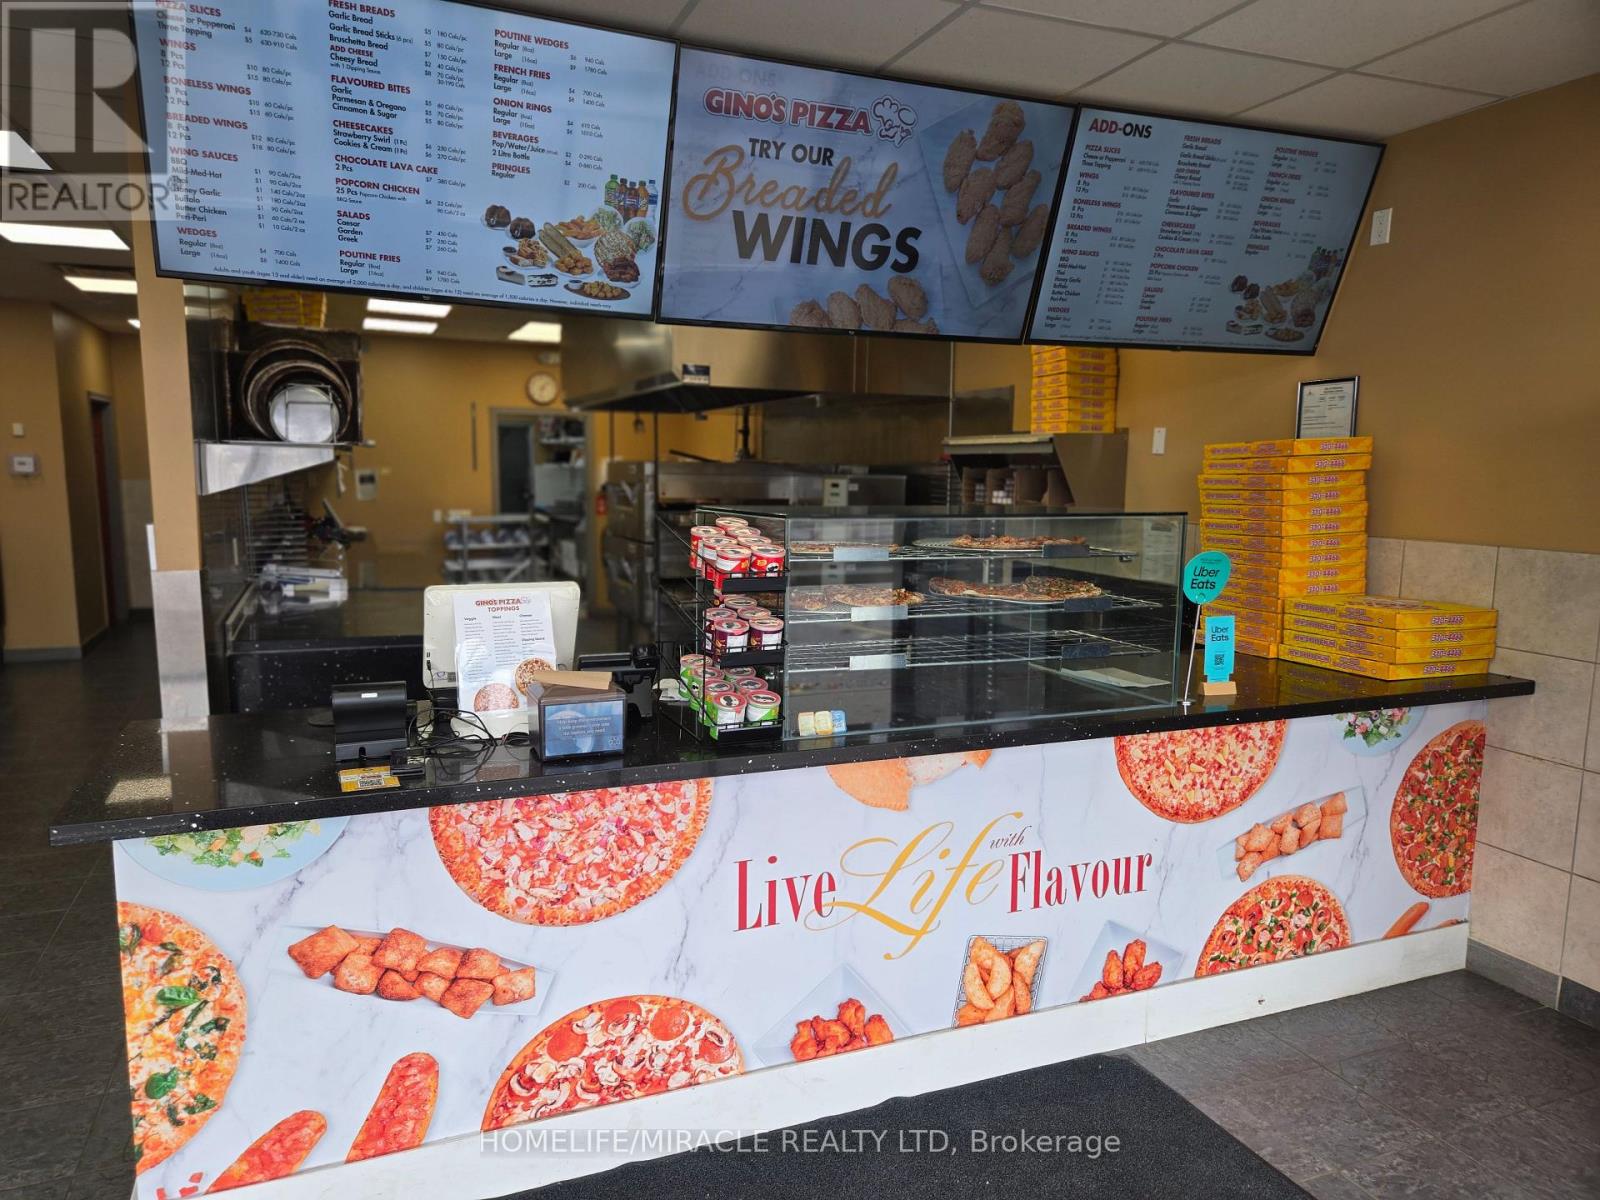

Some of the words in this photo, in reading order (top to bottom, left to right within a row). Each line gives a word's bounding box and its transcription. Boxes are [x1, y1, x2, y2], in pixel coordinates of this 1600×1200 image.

[190, 4, 222, 16] SLICES
[328, 0, 357, 10] FRESH
[360, 4, 396, 18] BREADS
[328, 10, 350, 20] Garlic
[352, 14, 373, 24] Bread
[157, 21, 180, 31] Three
[180, 25, 212, 39] Topping
[197, 18, 236, 30] Pepperoni
[329, 23, 350, 33] Garlic
[352, 27, 374, 36] Bread
[376, 30, 395, 40] Sticks
[159, 38, 196, 50] WINGS
[330, 34, 366, 46] Bruschetta
[368, 40, 388, 50] Bread
[494, 29, 532, 42] POUTINE
[534, 36, 569, 49] WEDGES
[494, 40, 520, 50] Regular
[330, 44, 346, 52] ADD
[348, 48, 374, 58] CHEESE
[494, 49, 512, 60] Large
[330, 53, 355, 65] Cheesy
[358, 57, 378, 66] Bread
[494, 64, 526, 76] FRENCH
[529, 70, 550, 80] FRIES
[331, 74, 384, 90] FLAVOURED
[388, 84, 410, 94] BITES
[494, 74, 518, 84] Regular
[164, 76, 213, 90] BONELESS
[216, 83, 252, 96] WINGS
[332, 86, 352, 95] Garlic
[494, 83, 512, 92] Large
[332, 94, 366, 106] Parmesan
[376, 101, 406, 112] Oregano
[493, 98, 524, 108] ONION
[526, 102, 552, 114] RINGS
[332, 103, 368, 114] Cinnamon
[377, 110, 397, 119] Sugar
[493, 108, 518, 118] Regular
[704, 88, 787, 123] GINO'S
[790, 98, 872, 136] PIZZA
[165, 112, 210, 124] BREADED
[213, 118, 248, 130] WINGS
[333, 120, 394, 134] CHEESECAKES
[493, 116, 510, 126] Large
[1088, 118, 1152, 139] ADD-ONS
[334, 129, 371, 142] Strawberry
[374, 134, 390, 143] Swirl
[492, 130, 540, 144] BEVERAGES
[334, 138, 360, 148] Cookies
[371, 144, 392, 152] Cream
[492, 140, 546, 153] Pop/Water/Juice
[170, 146, 199, 157] WING
[202, 150, 238, 162] SAUCES
[498, 150, 512, 158] Litre
[513, 152, 530, 160] Bottle
[748, 138, 786, 160] TRY
[792, 144, 834, 166] OUR
[335, 154, 388, 168] CHOCOLATE
[390, 162, 414, 171] LAVA
[416, 166, 438, 174] CAKE
[492, 162, 530, 174] PRINGLES
[492, 170, 515, 179] Regular
[336, 178, 380, 190] POPCORN
[382, 184, 420, 194] CHICKEN
[682, 144, 898, 221] Breaded
[200, 188, 222, 196] Garlic
[174, 195, 200, 204] Buffalo
[199, 206, 228, 216] Chicken
[336, 210, 370, 220] SALADS
[337, 219, 360, 228] Caesar
[176, 227, 218, 238] WEDGES
[338, 227, 363, 236] Garden
[180, 238, 206, 248] Regular
[732, 210, 923, 274] WINGS
[180, 248, 200, 258] Large
[340, 250, 377, 260] POUTINE
[379, 254, 400, 262] FRIES
[340, 259, 365, 268] Regular
[340, 267, 358, 275] Large
[1194, 565, 1220, 578] Uber
[1190, 578, 1216, 590] Eats
[1212, 626, 1229, 634] Uber
[990, 825, 1032, 850] with
[804, 811, 1024, 960] Life
[1008, 849, 1152, 914] Flavour
[733, 856, 836, 932] Live
